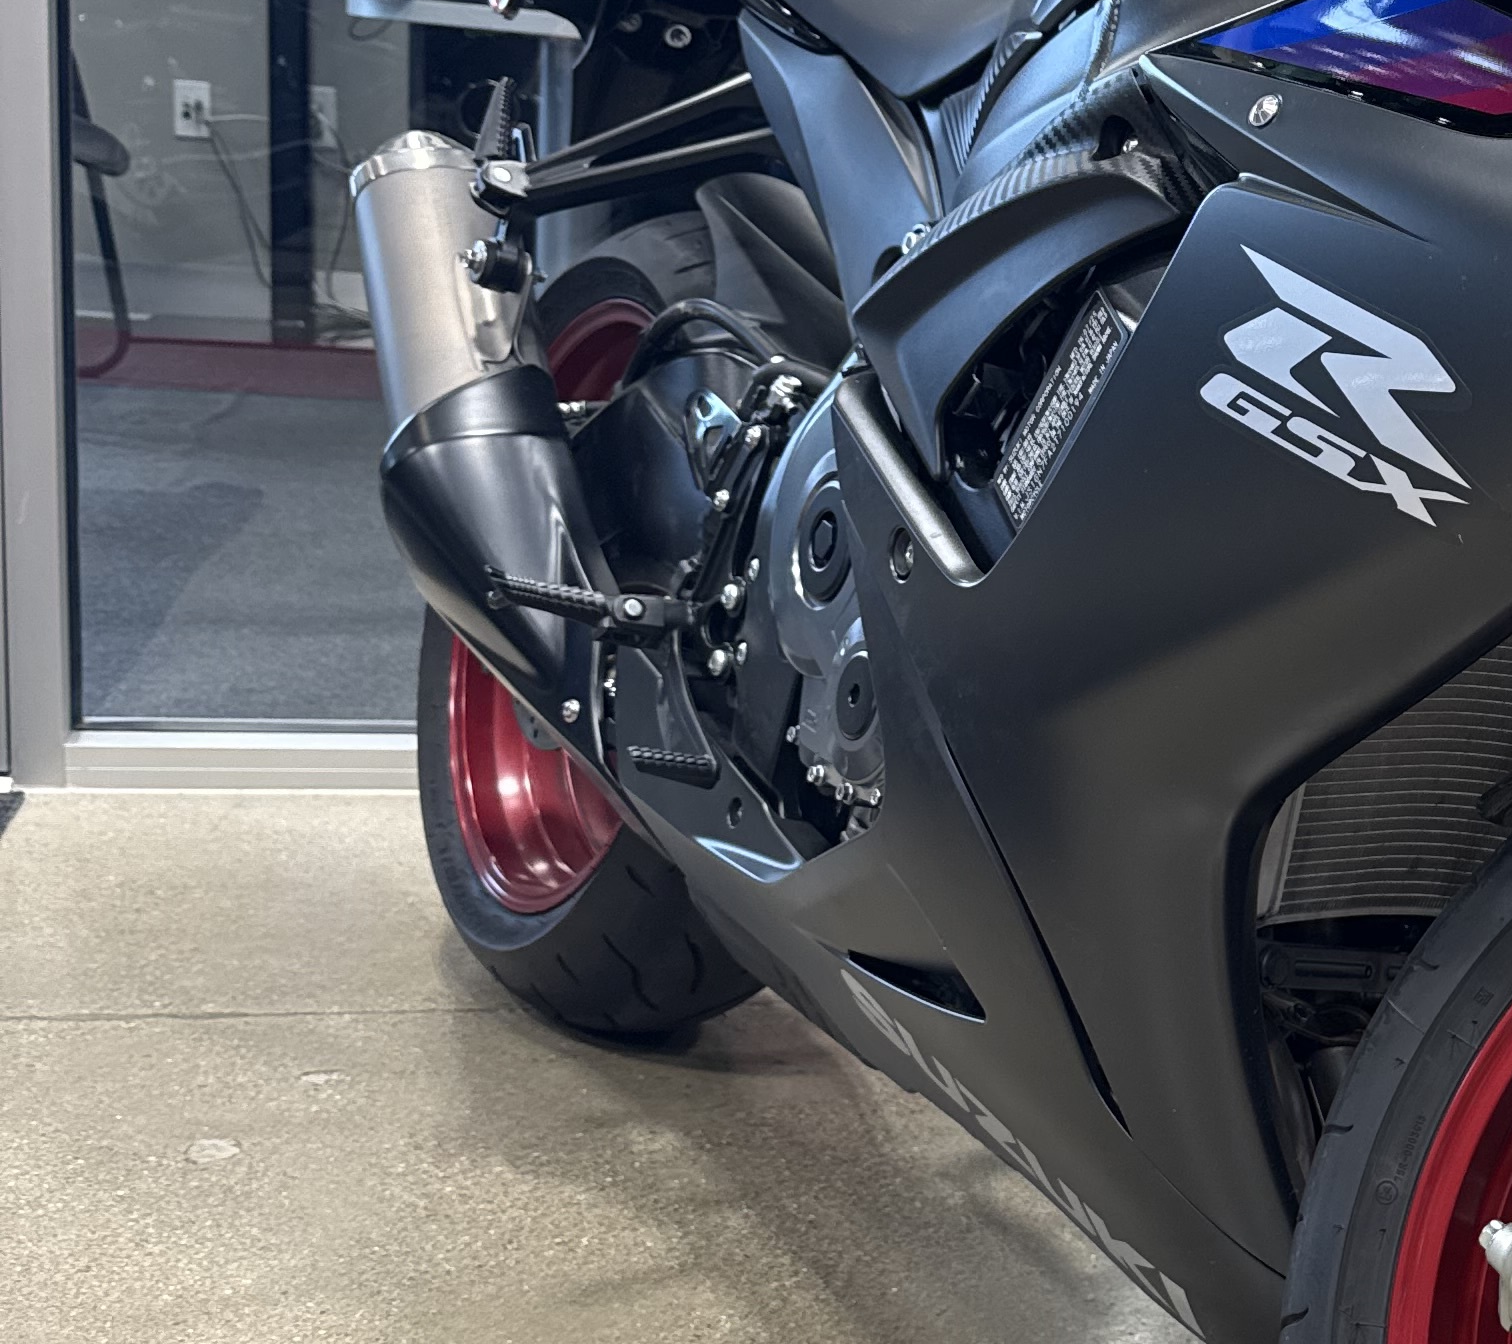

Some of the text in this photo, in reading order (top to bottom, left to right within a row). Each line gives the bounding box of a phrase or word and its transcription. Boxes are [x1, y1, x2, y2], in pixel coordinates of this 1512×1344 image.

[1098, 364, 1106, 373] IN
[1106, 340, 1119, 363] JAPAN
[1022, 413, 1037, 436] MOTOR
[1036, 365, 1062, 413] CORPORATION
[841, 969, 1206, 1339] SUZUKI
